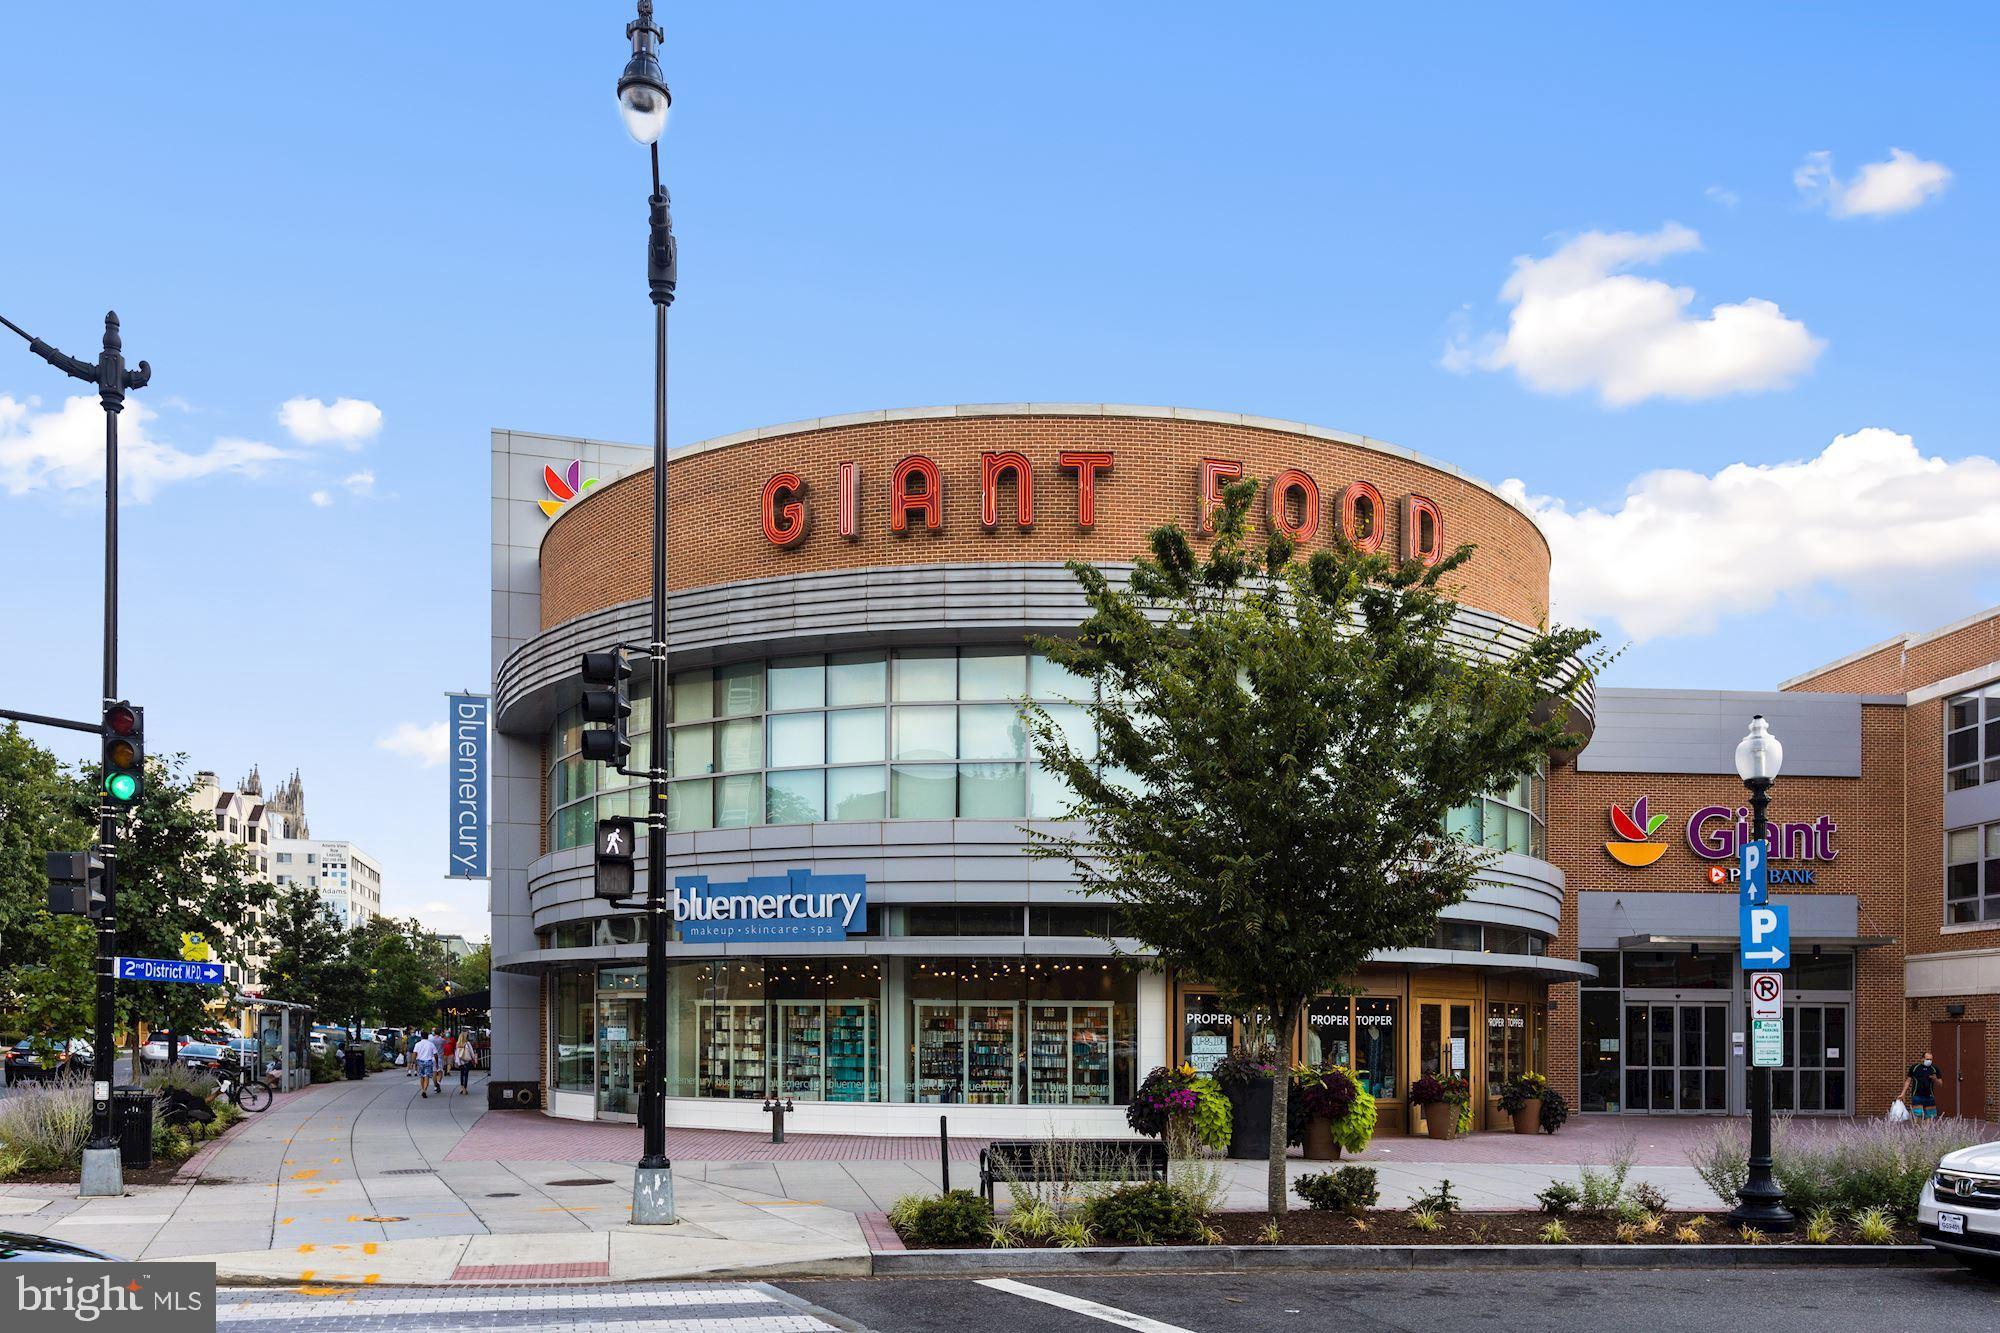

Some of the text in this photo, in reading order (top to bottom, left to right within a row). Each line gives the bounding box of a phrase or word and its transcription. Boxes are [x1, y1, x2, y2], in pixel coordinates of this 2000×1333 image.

[762, 451, 1443, 566] GIANT FOOD
[452, 703, 484, 869] bluemercury
[1745, 845, 1760, 881] P
[1768, 870, 1816, 884] BANK
[673, 886, 862, 927] bluemercury
[690, 924, 833, 937] makeup skincare spa
[1751, 909, 1778, 944] P
[125, 960, 145, 976] 2nd
[145, 962, 183, 979] District
[1186, 1013, 1232, 1025] PROPER
[1311, 1014, 1392, 1026] PROPER TOPPER
[1507, 1017, 1524, 1027] TOPPER
